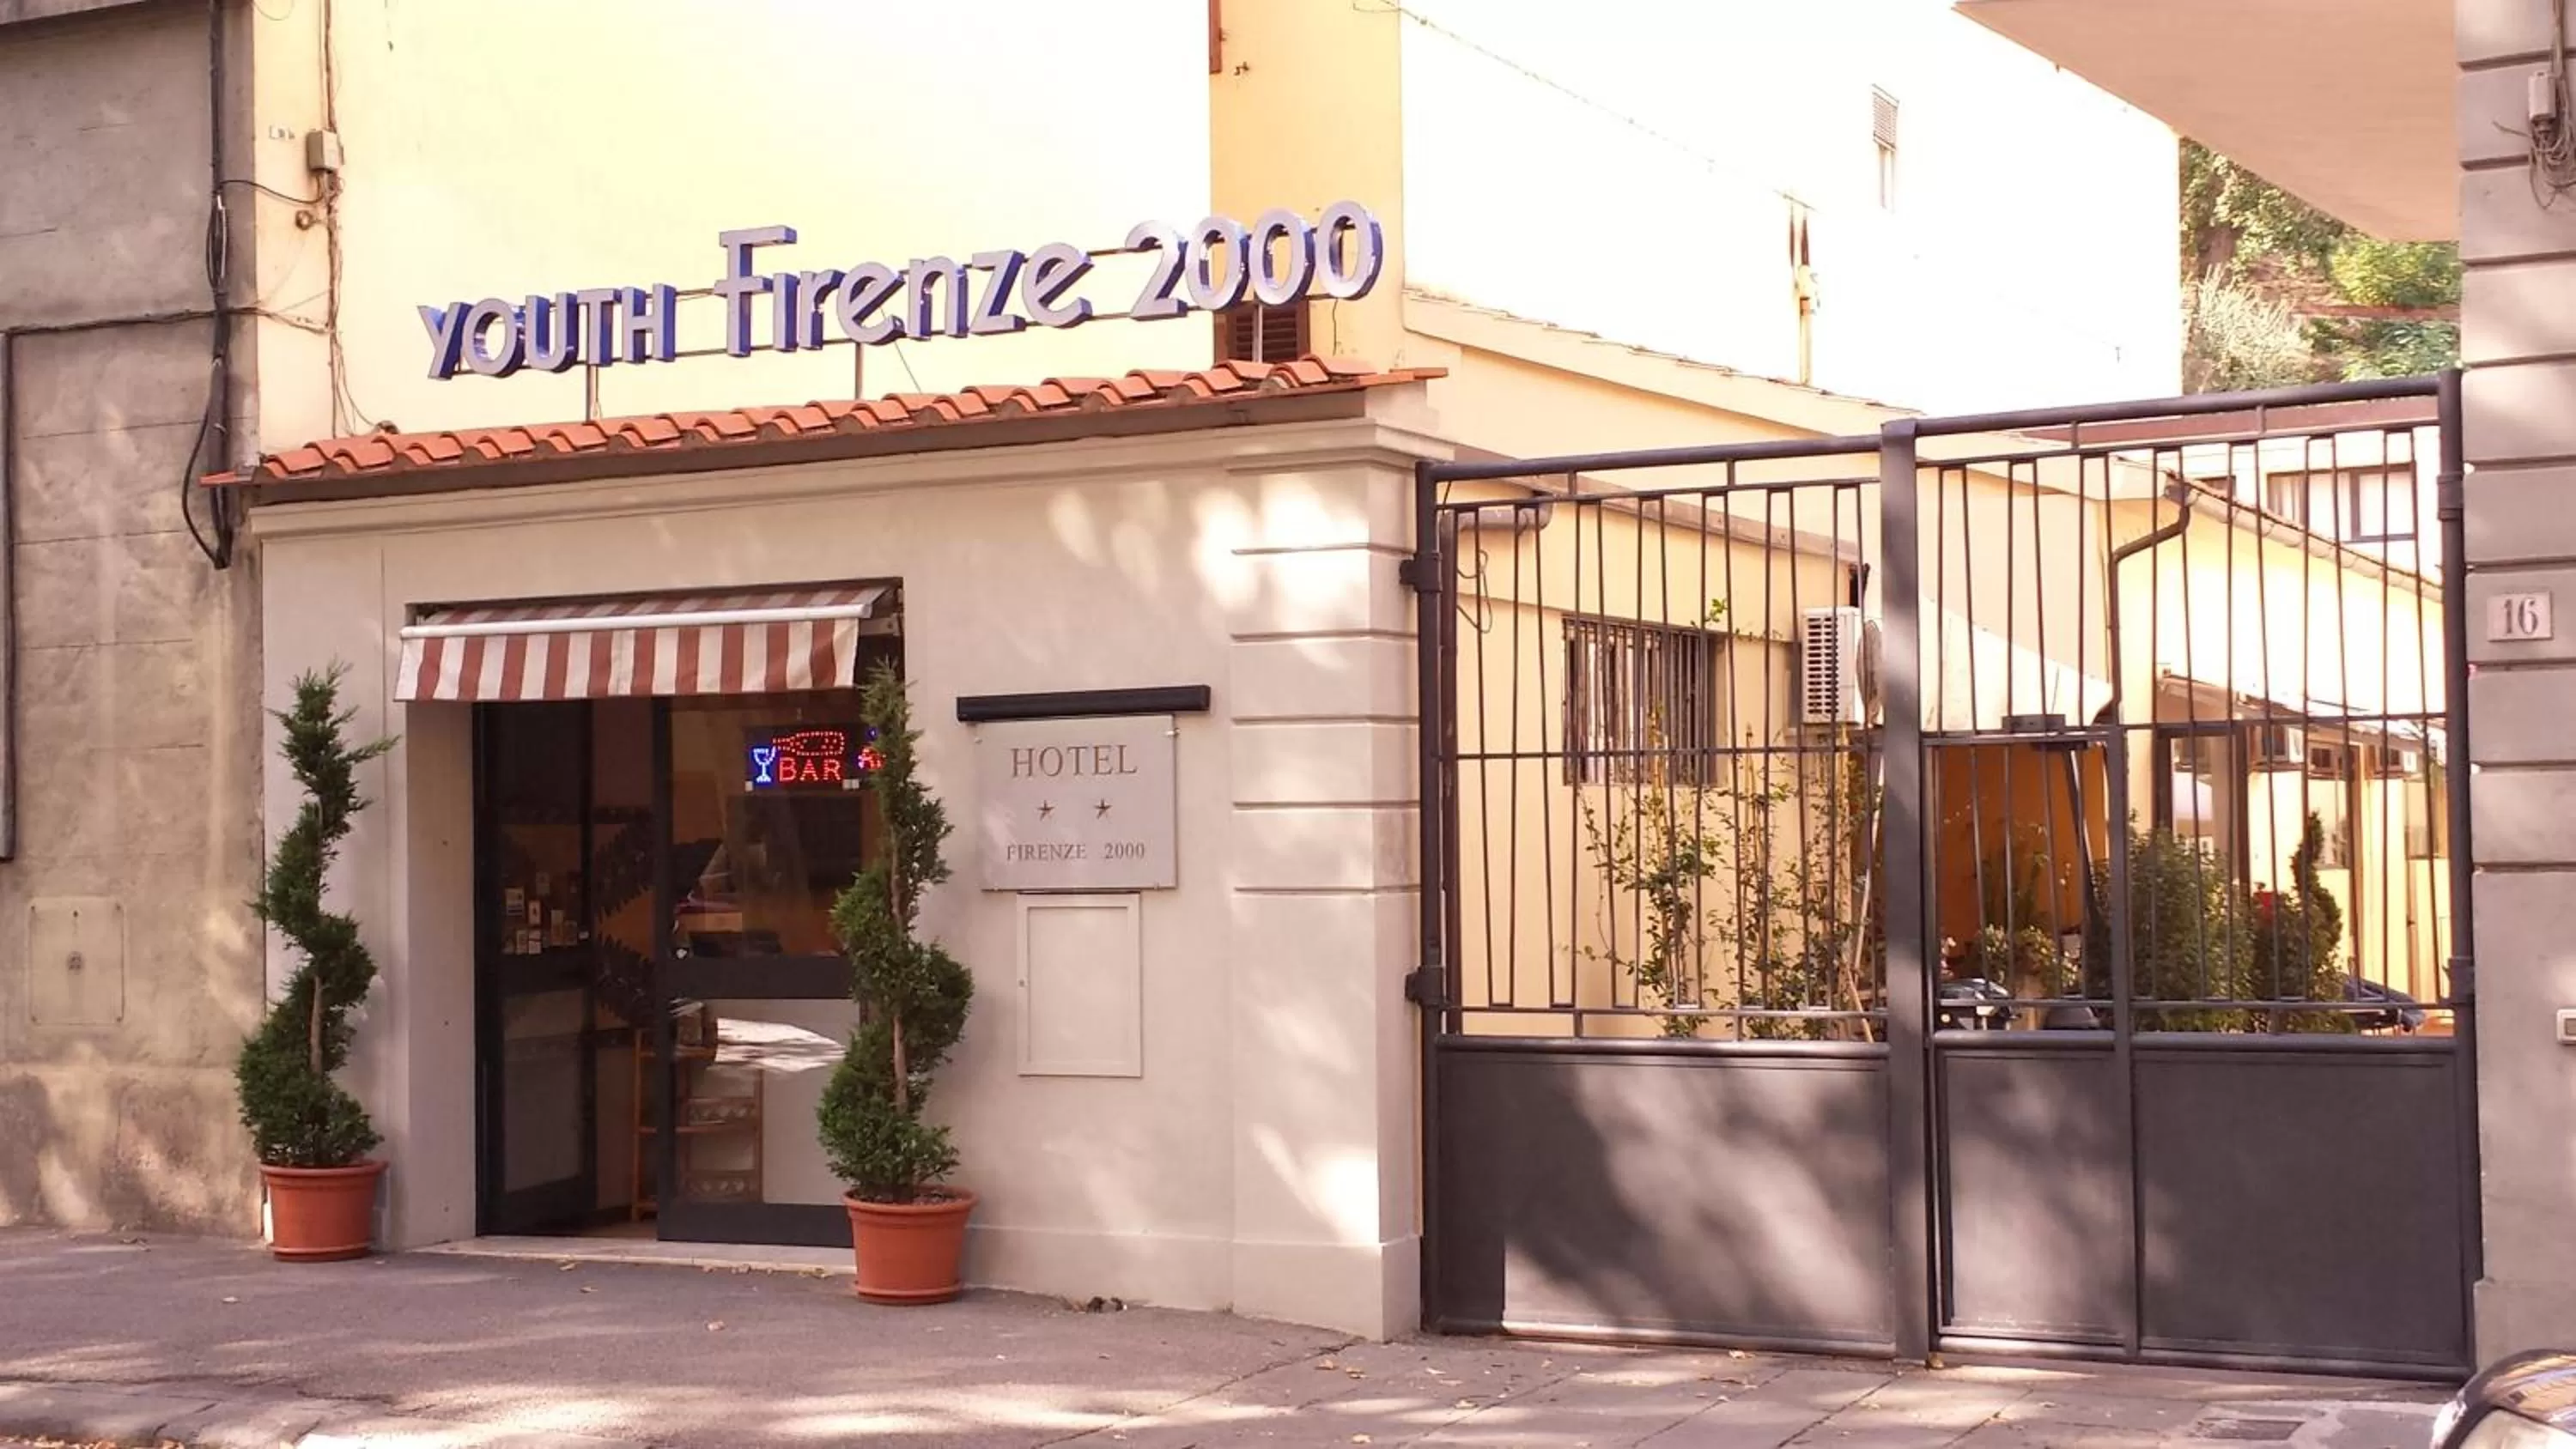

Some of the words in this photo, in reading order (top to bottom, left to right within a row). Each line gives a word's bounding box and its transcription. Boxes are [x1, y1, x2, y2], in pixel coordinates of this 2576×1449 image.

[416, 283, 677, 380] YOUTH
[714, 225, 1095, 357] Firenze
[1124, 200, 1383, 321] 2000
[2502, 597, 2539, 635] 16
[778, 756, 842, 782] BAR
[1010, 743, 1139, 778] HOTEL
[1006, 843, 1088, 861] FIRENZE
[1104, 842, 1146, 859] 2000
